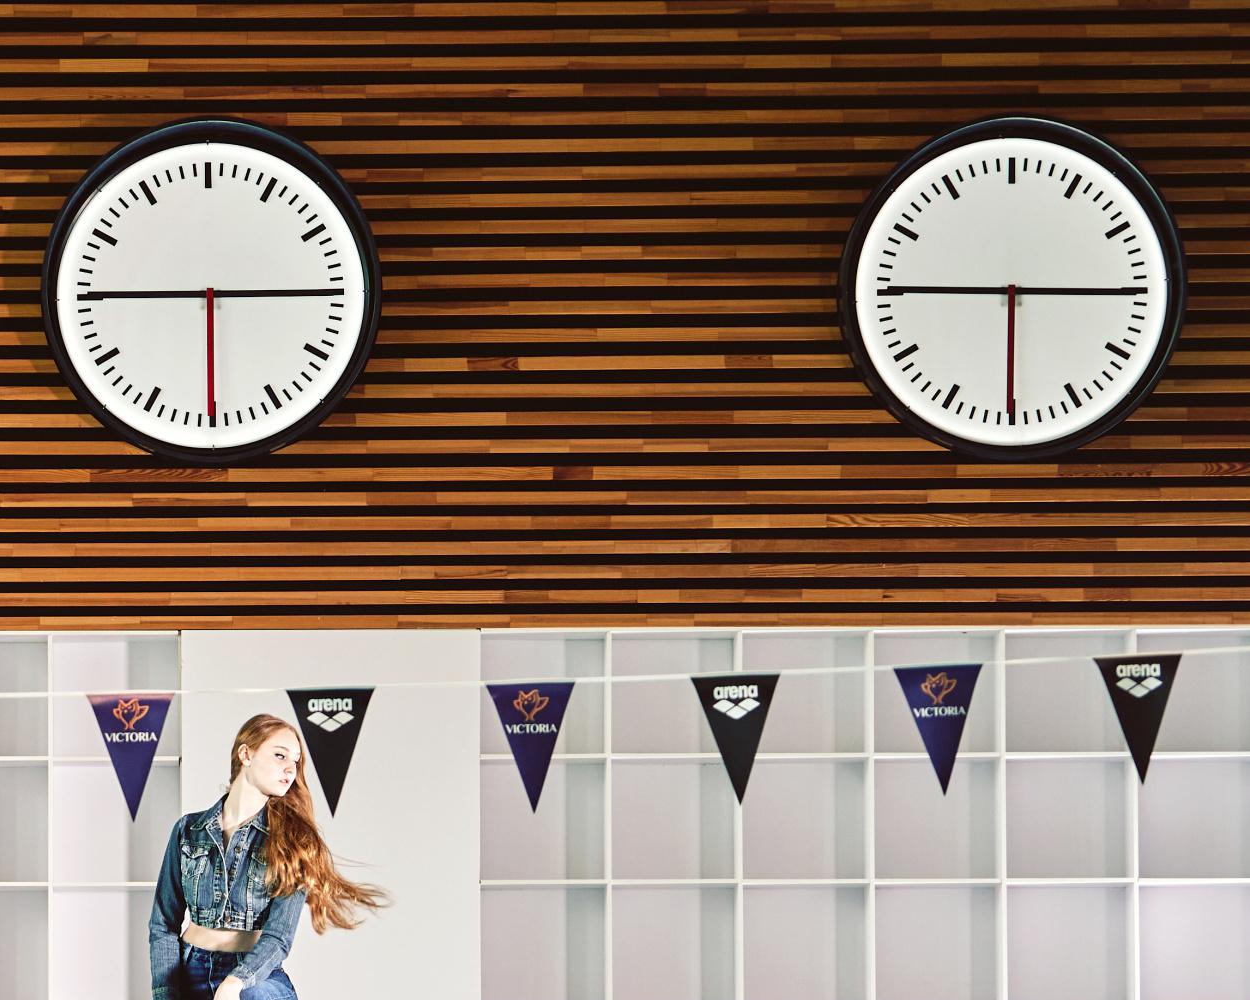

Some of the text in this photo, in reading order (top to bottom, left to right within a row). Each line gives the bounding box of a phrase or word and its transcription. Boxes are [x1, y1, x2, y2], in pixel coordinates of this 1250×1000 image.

[1116, 663, 1161, 677] arena
[713, 684, 759, 700] arena
[308, 697, 353, 712] arena
[913, 705, 966, 719] VICTORIA
[505, 723, 558, 735] VICTORIA
[105, 731, 158, 743] VICTORIA
